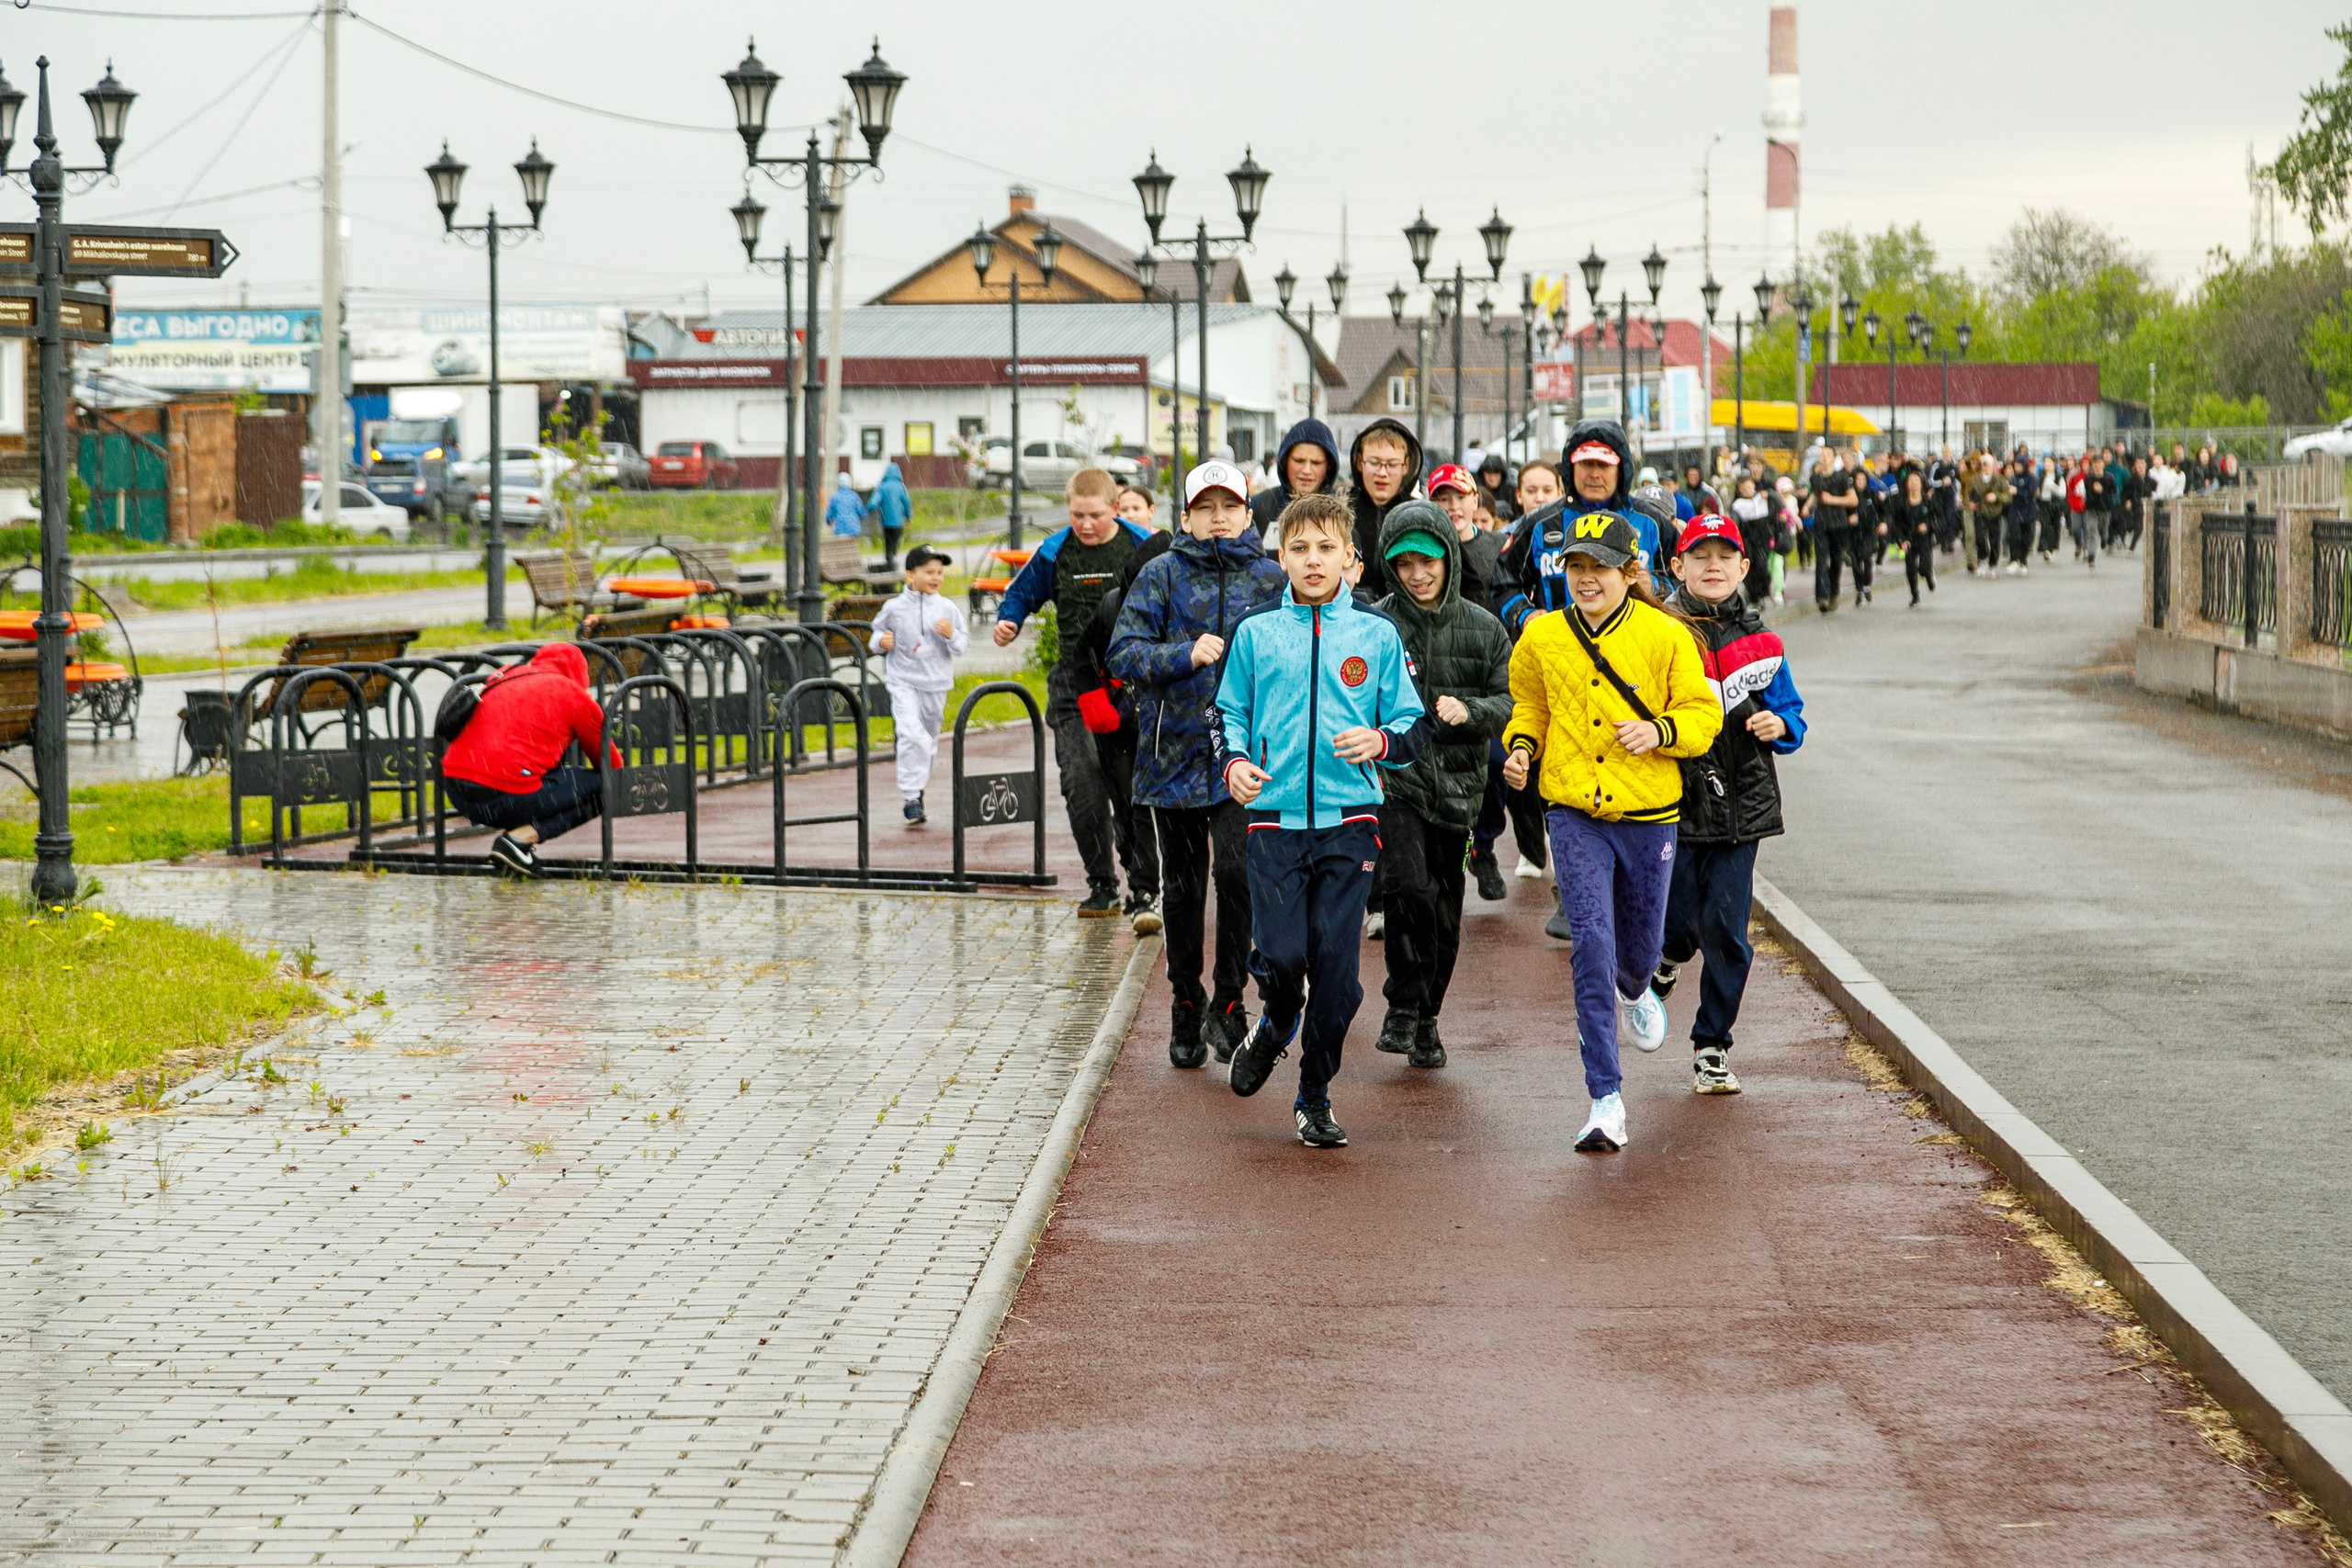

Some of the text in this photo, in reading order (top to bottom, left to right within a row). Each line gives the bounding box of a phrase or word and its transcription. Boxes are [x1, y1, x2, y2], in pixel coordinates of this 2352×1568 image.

[7, 248, 26, 257] Street
[74, 239, 81, 248] G.
[82, 240, 89, 248] A.
[130, 243, 151, 251] estate
[151, 243, 187, 252] warehouse
[130, 252, 148, 260] street
[167, 314, 290, 340] ВЫГОДНО
[241, 352, 299, 370] ЦЕНТР
[1575, 513, 1614, 539] W
